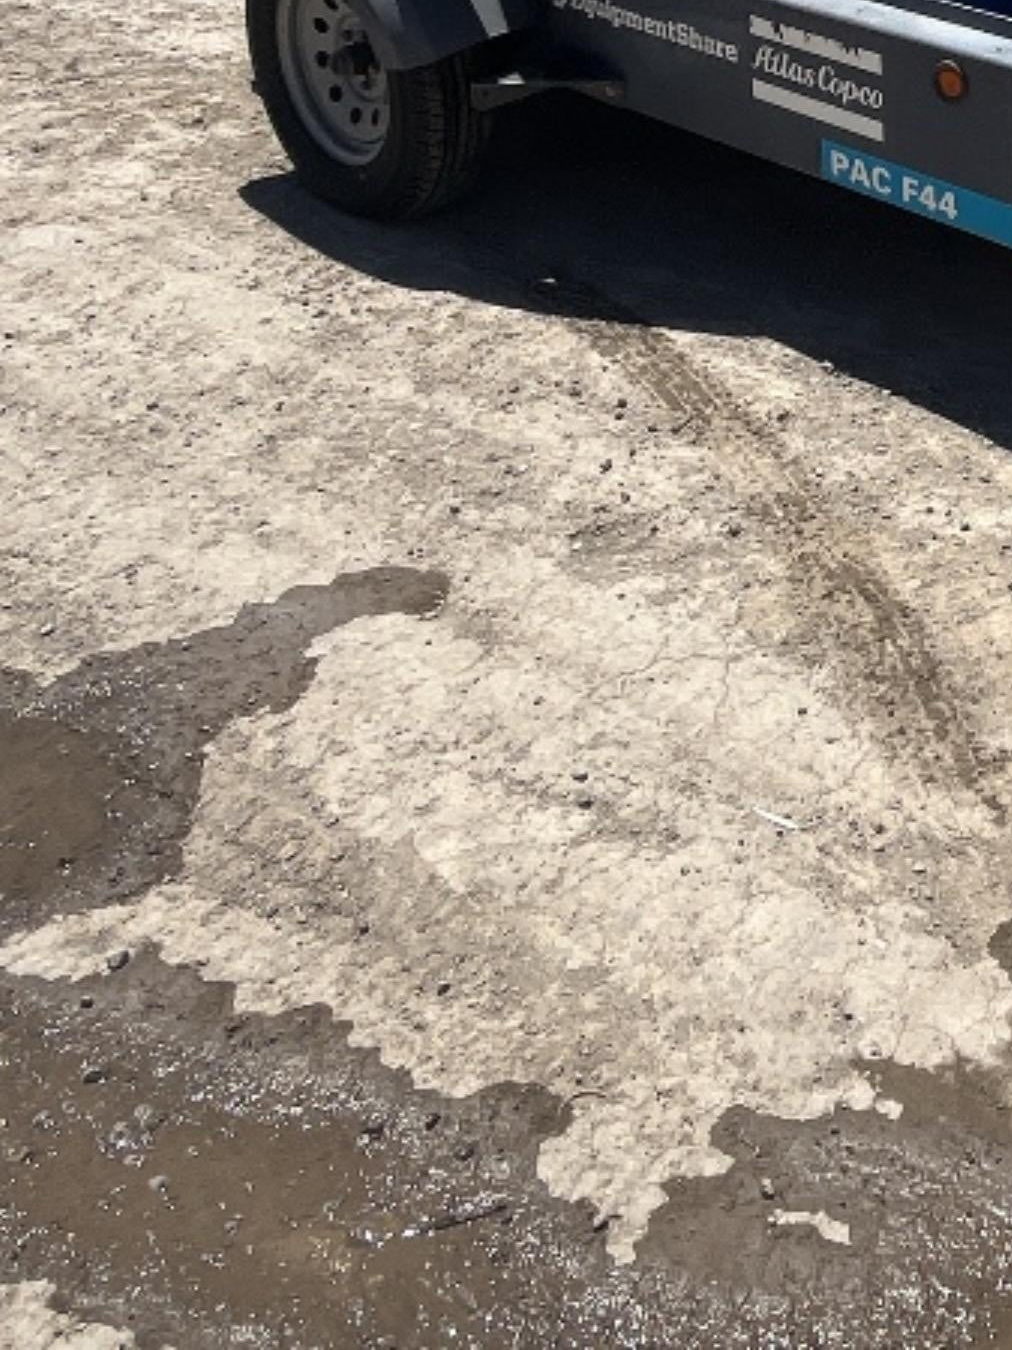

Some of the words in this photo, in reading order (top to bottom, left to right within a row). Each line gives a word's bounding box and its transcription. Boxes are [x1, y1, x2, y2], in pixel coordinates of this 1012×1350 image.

[751, 45, 815, 88] Atlas
[817, 65, 883, 108] Copco
[829, 149, 892, 194] PAC
[902, 176, 958, 220] F44
